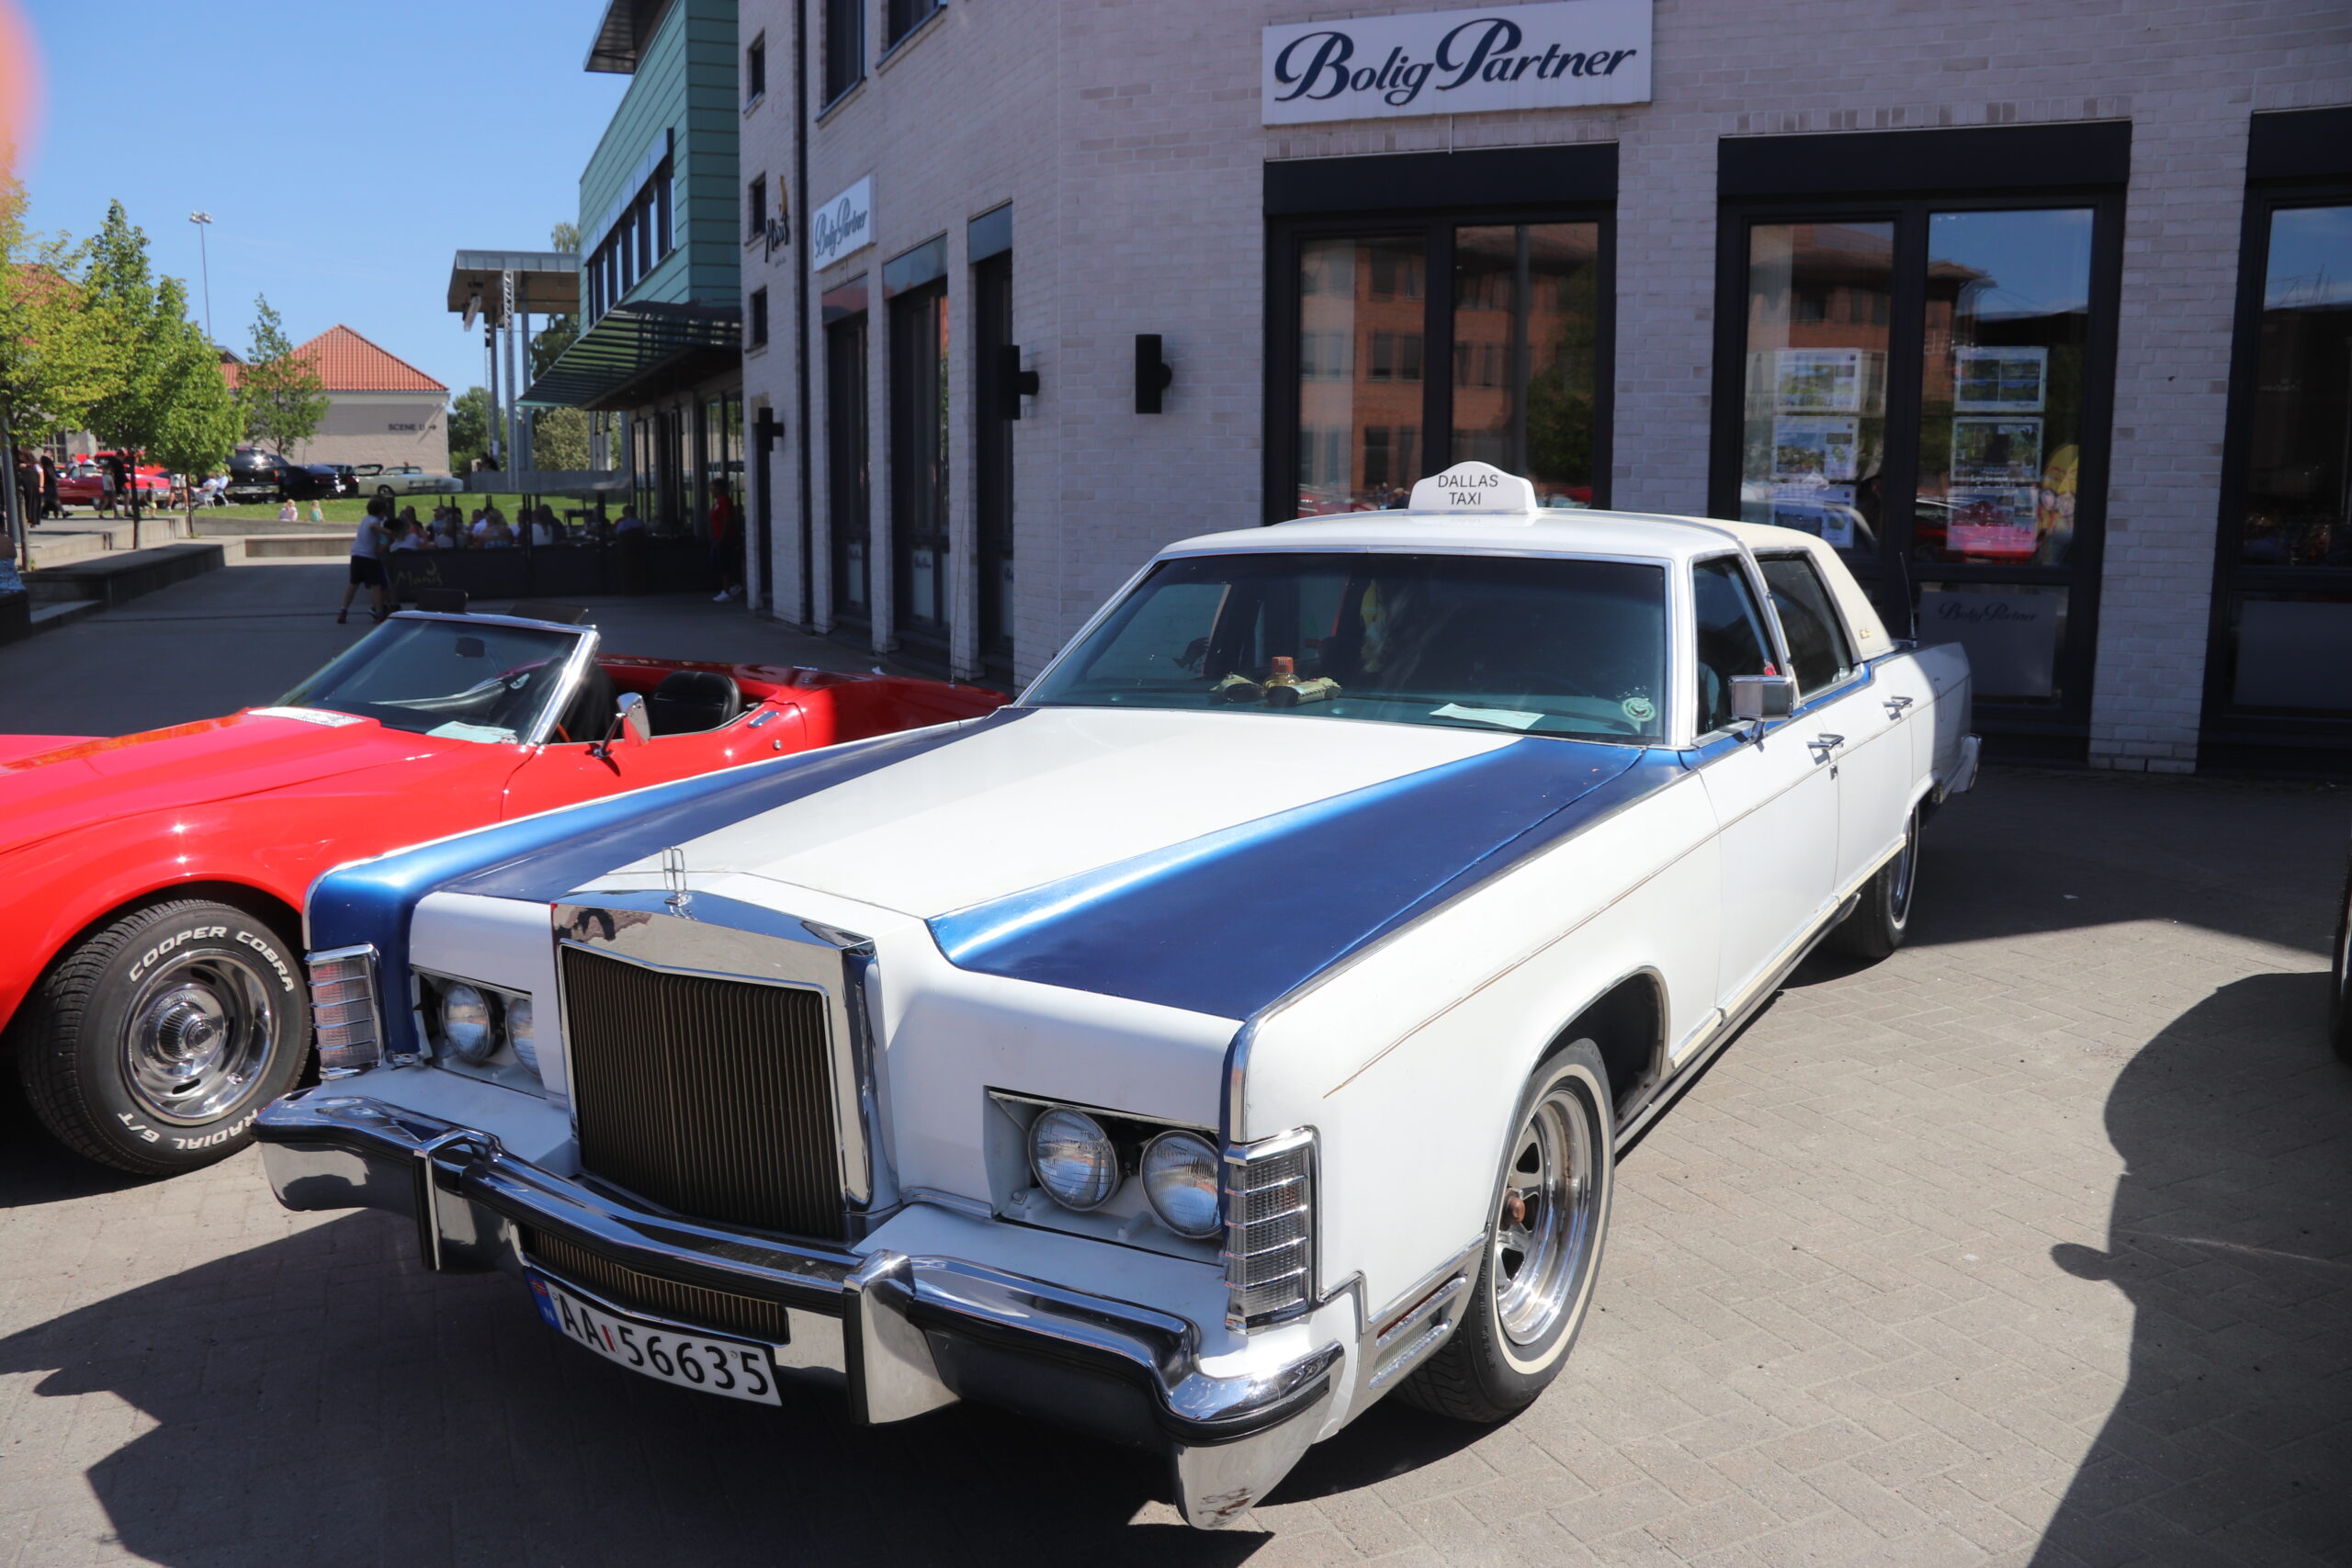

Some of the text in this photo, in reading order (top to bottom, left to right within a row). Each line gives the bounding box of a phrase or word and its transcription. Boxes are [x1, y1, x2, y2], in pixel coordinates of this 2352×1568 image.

[1438, 474, 1498, 488] DALLAS
[1448, 491, 1481, 505] TAXI
[129, 926, 295, 993] COOPER COBRA
[117, 1112, 162, 1144] G/T
